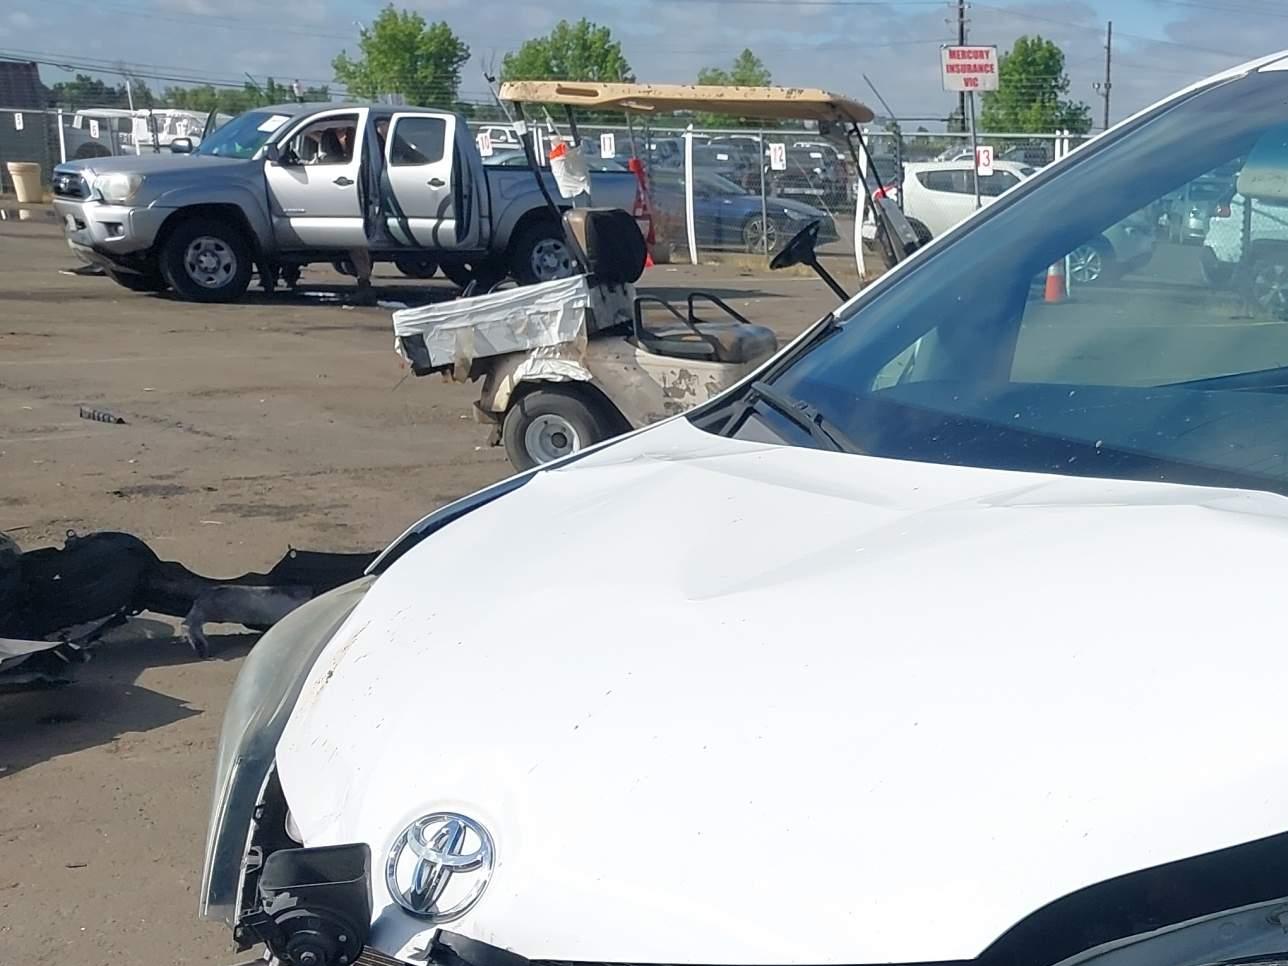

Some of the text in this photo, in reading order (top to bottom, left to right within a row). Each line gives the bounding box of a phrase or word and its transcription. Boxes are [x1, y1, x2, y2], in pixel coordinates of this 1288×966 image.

[948, 49, 990, 60] MERCURY
[946, 63, 994, 74] INSURANCE
[963, 77, 979, 87] VIC
[773, 145, 784, 162] 12
